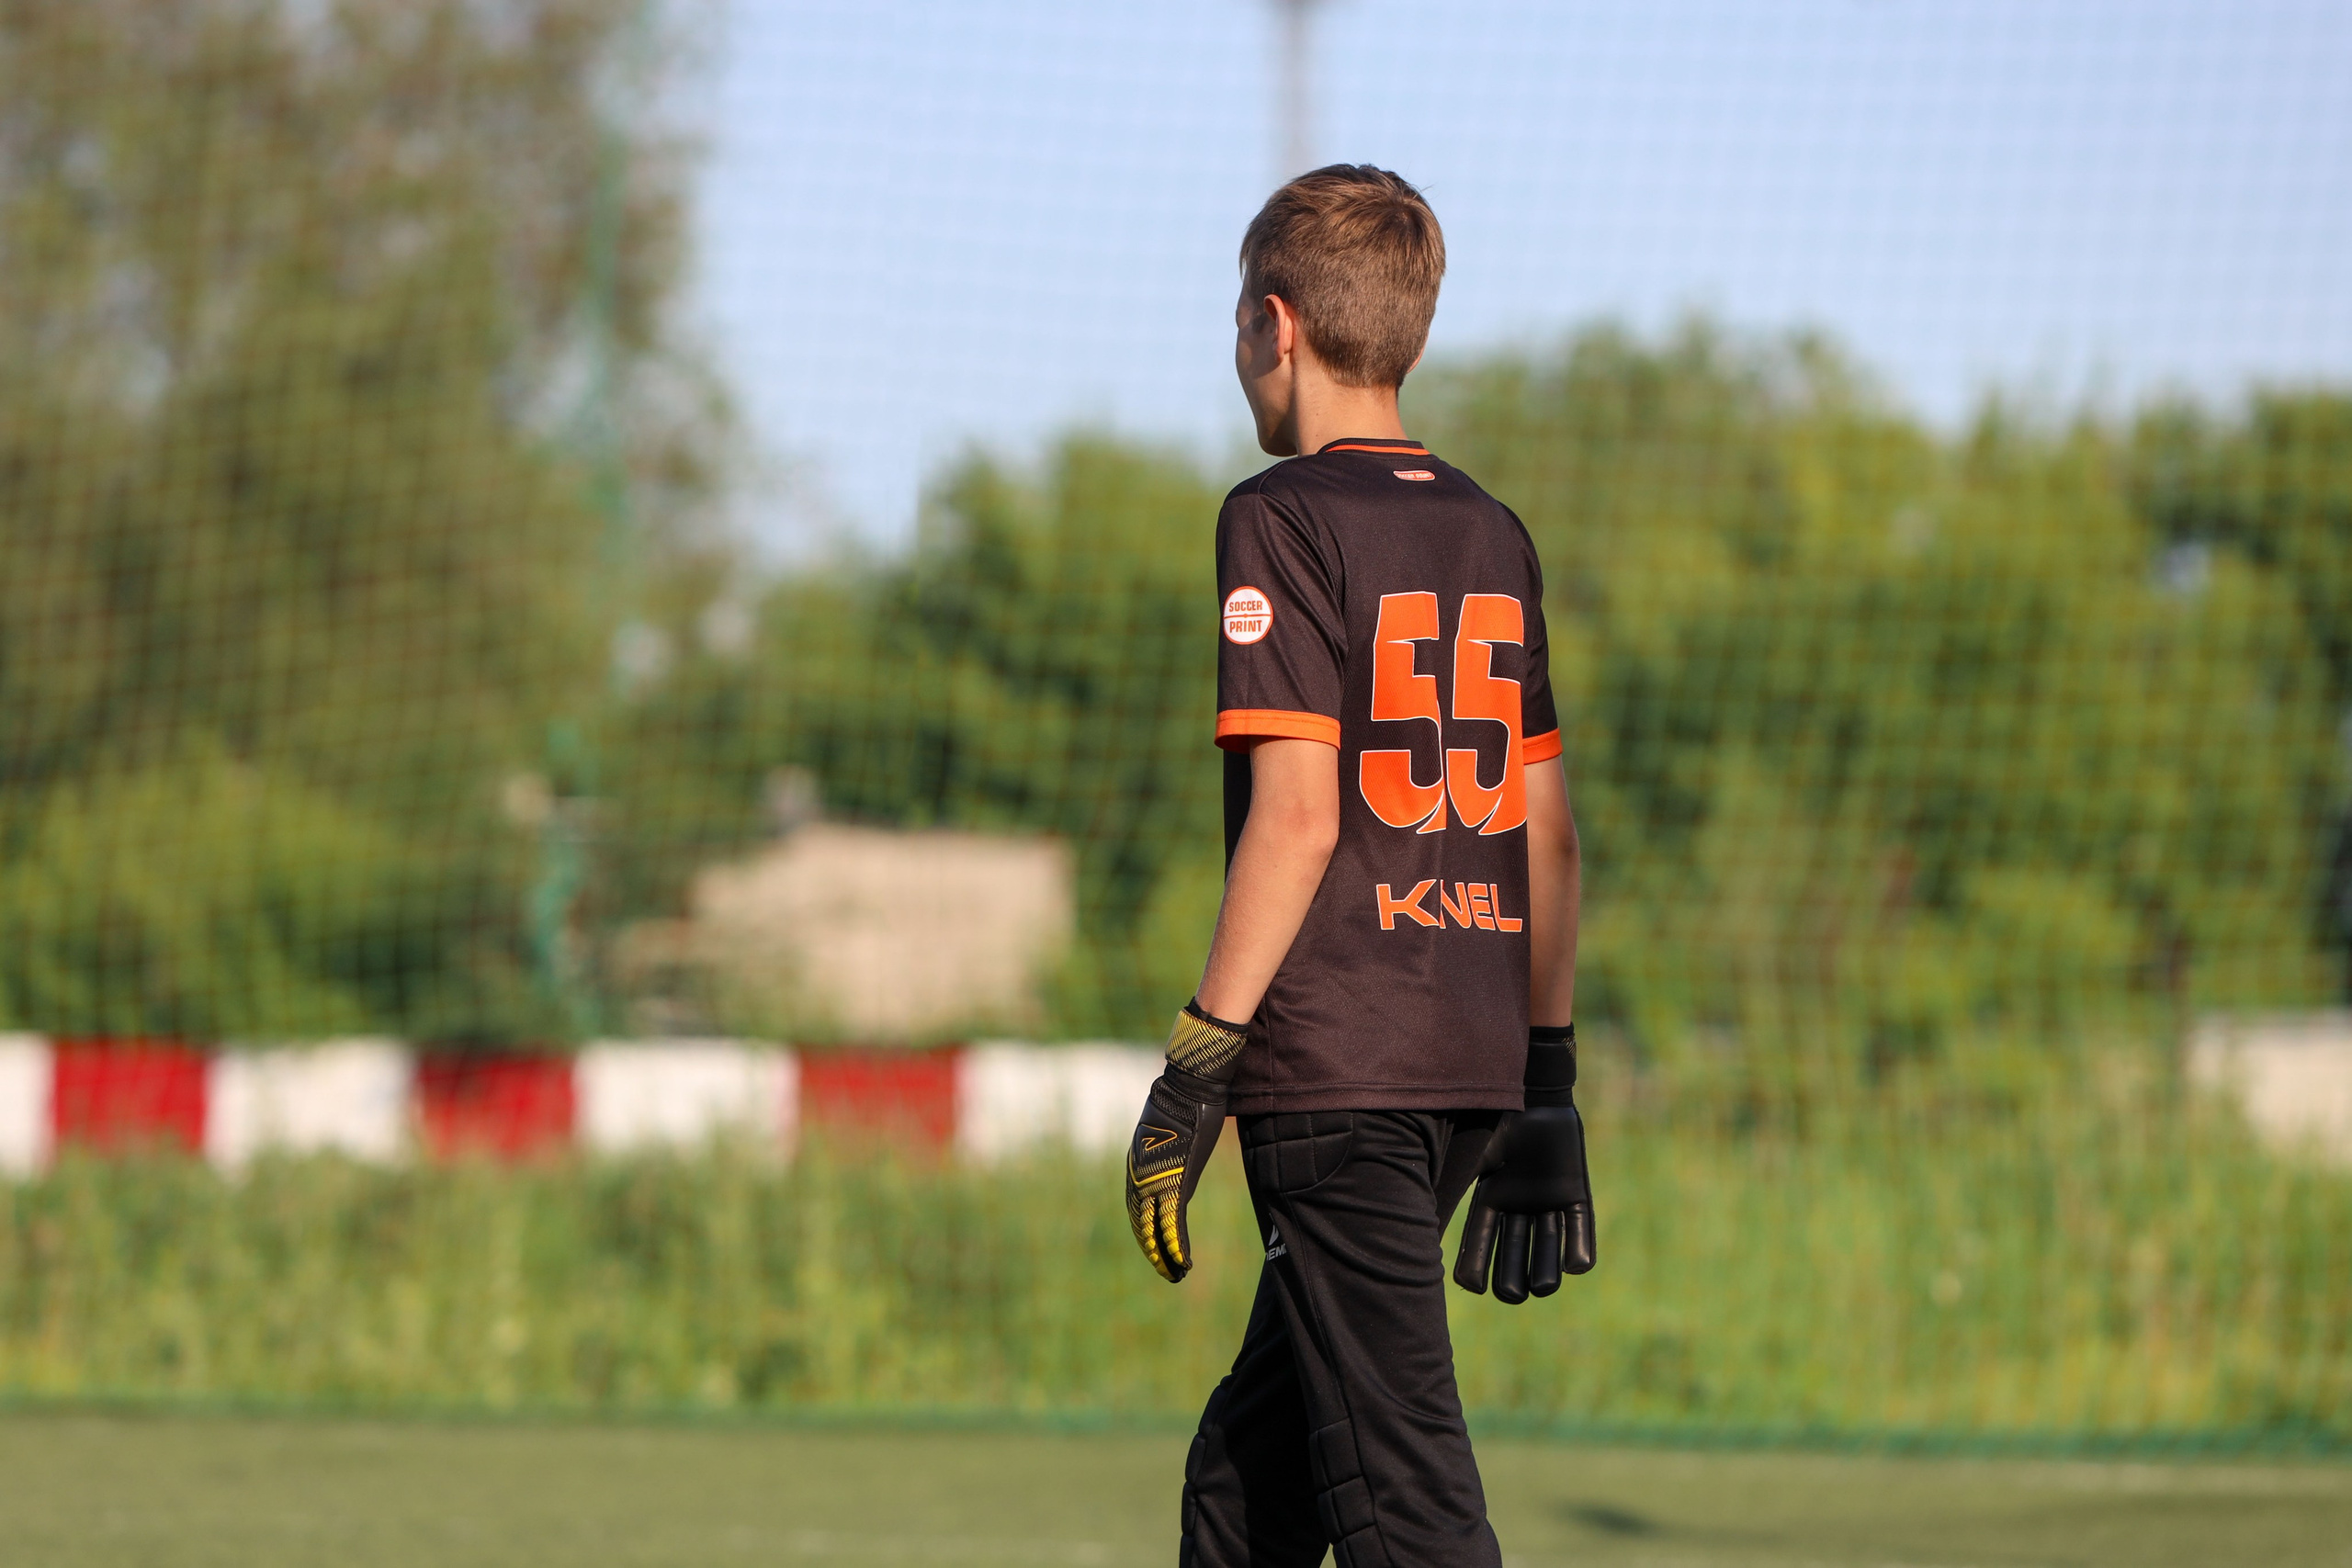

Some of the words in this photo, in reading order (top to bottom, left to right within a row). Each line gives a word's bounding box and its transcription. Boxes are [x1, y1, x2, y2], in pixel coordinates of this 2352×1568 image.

[1228, 600, 1263, 613] SOCCER
[1229, 619, 1262, 633] PRINT
[1359, 591, 1527, 835] 55
